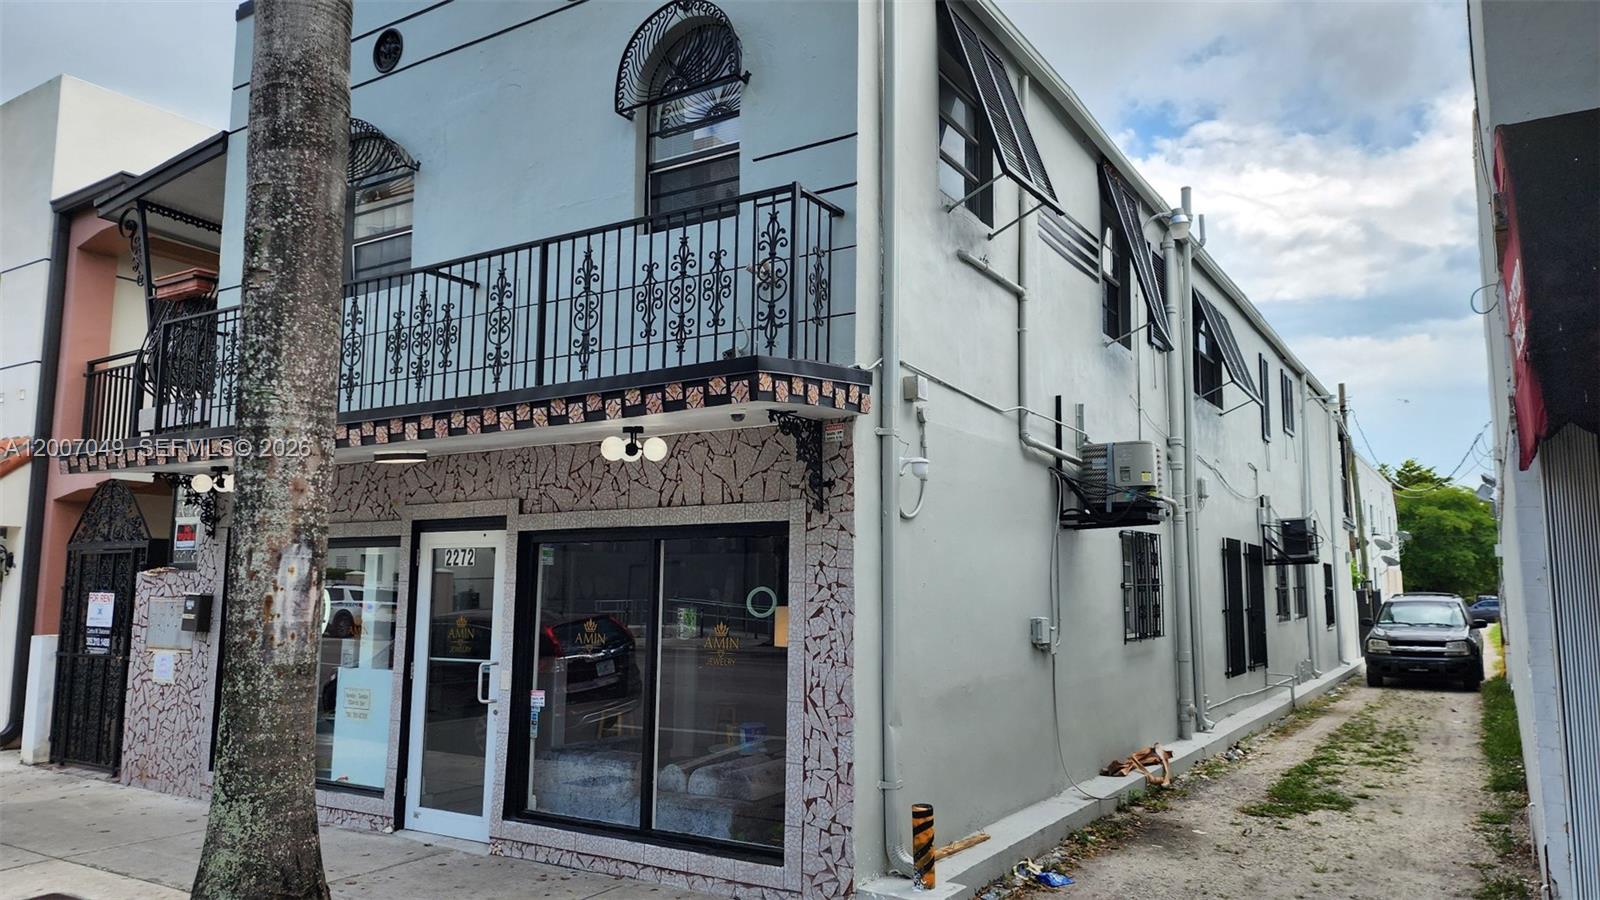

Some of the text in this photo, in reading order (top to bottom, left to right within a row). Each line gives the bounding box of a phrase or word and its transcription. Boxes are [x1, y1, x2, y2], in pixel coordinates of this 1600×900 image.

[445, 549, 474, 566] 2272
[448, 628, 474, 639] AMIN
[575, 633, 606, 645] AMIN
[704, 638, 739, 649] AMIN
